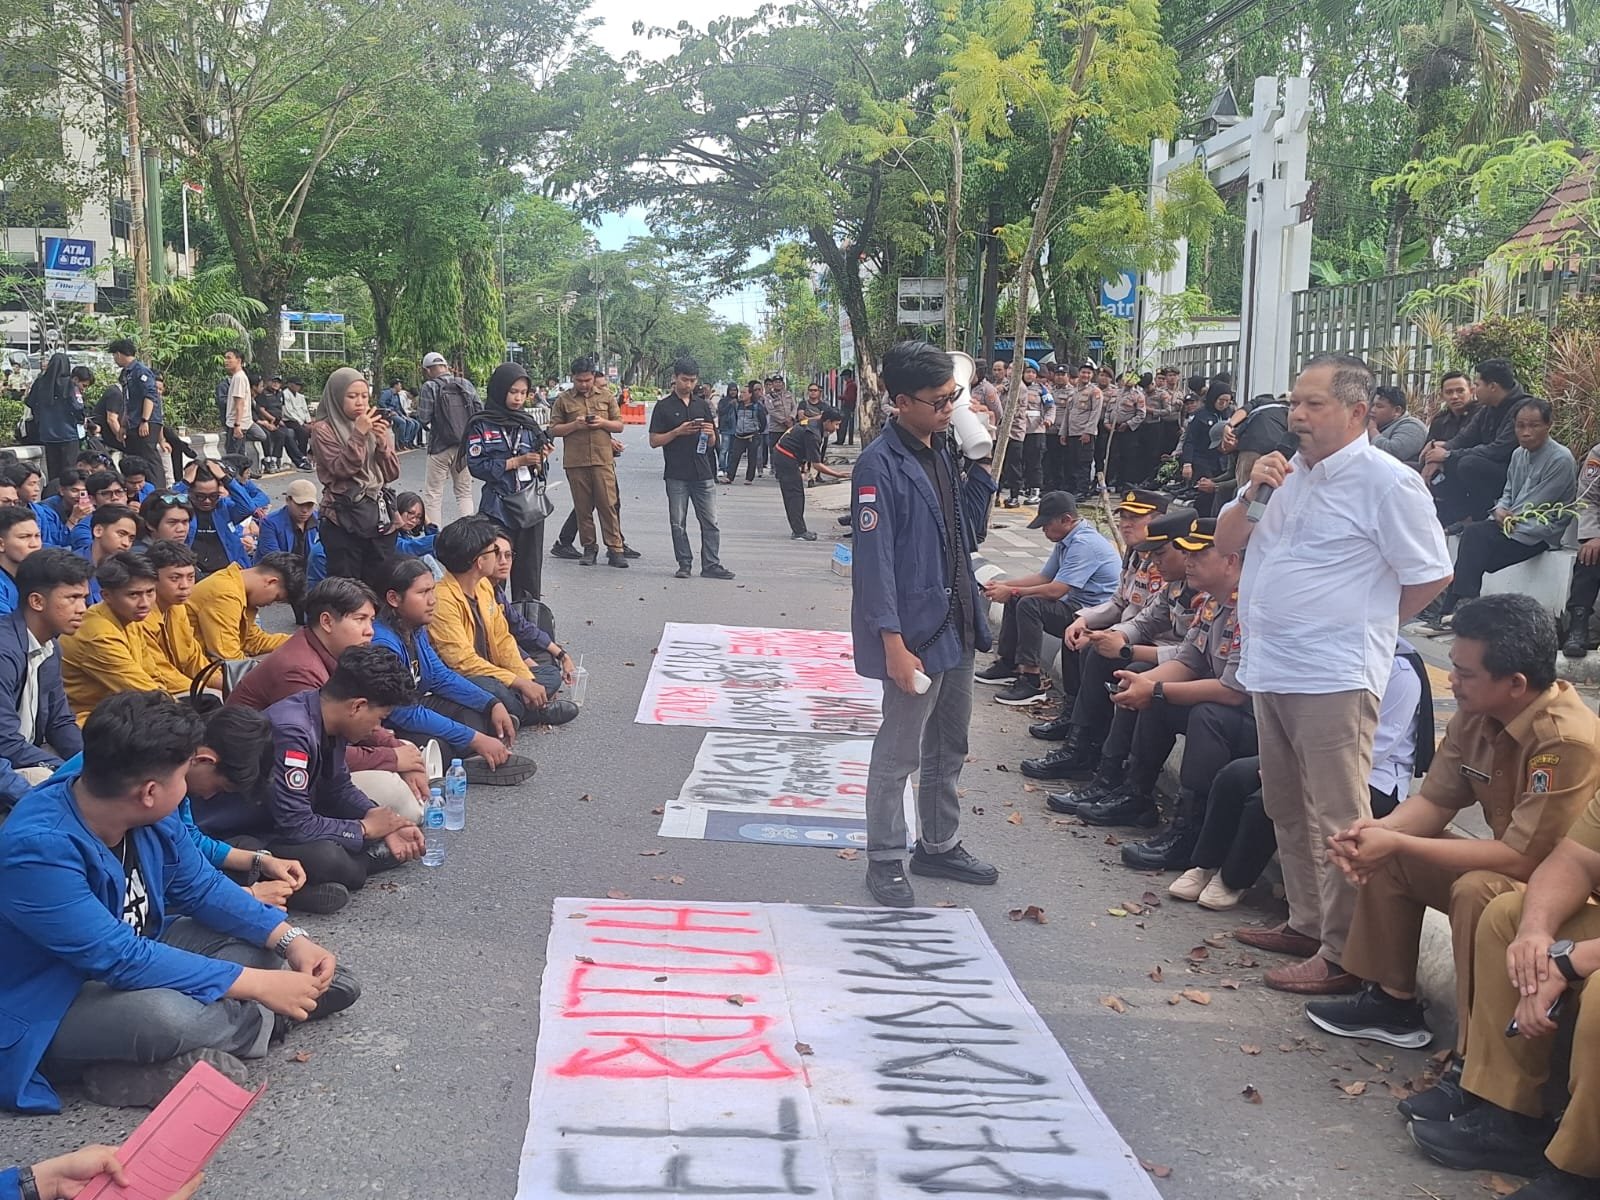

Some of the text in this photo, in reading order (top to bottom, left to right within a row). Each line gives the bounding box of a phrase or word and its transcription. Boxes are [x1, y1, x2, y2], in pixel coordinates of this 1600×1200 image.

[63, 244, 86, 256] ATM
[70, 256, 91, 267] BCA
[654, 640, 728, 722] TANPA GURU
[549, 905, 797, 1079] BUTUH
[805, 904, 1110, 1200] PENDIDIKAN
